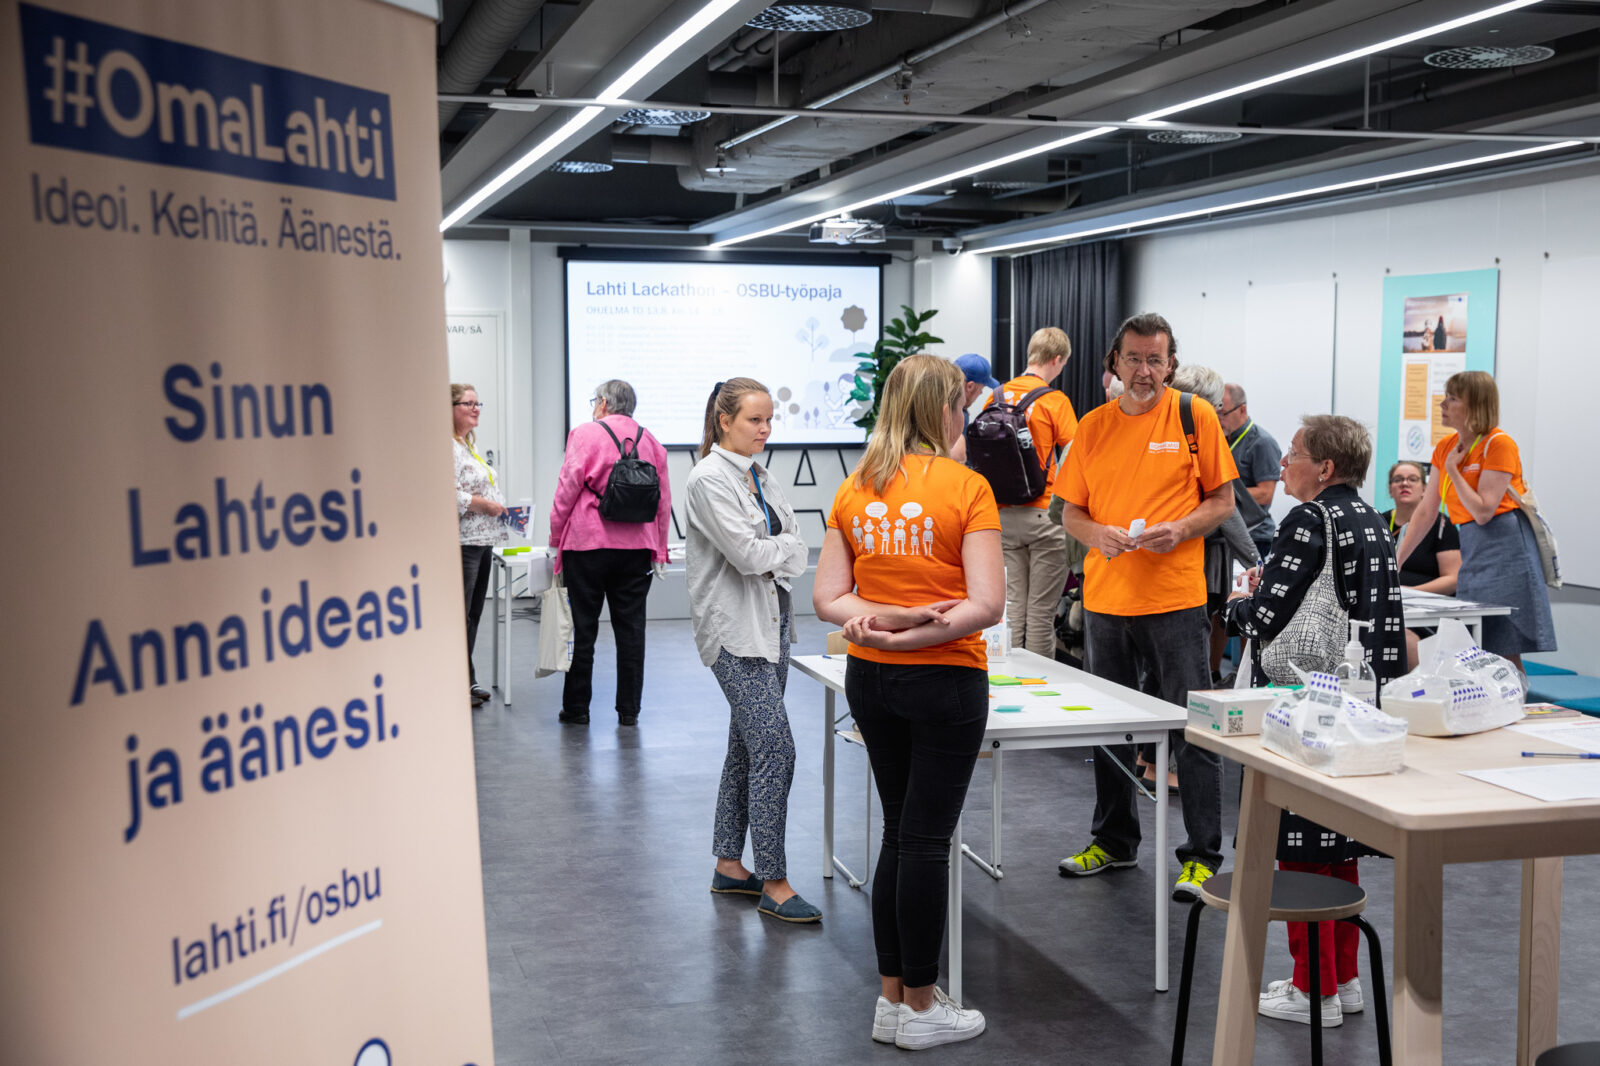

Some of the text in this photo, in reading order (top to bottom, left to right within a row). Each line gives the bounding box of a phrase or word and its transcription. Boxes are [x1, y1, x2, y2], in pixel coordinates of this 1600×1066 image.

[44, 36, 386, 180] #OmaLahti
[32, 173, 402, 260] Ideoi. Kehitä. Äänestä.
[586, 306, 629, 316] OHJELMA
[587, 281, 627, 296] Lahti
[632, 282, 715, 297] Lackathon
[736, 283, 842, 302] OSBU-työpaja
[162, 361, 334, 443] Sinun
[128, 467, 378, 567] Lahtesi.
[70, 563, 423, 706] Anna ideasi
[124, 673, 400, 843] ja äänesi.
[172, 866, 382, 985] lahti.fi/osbu
